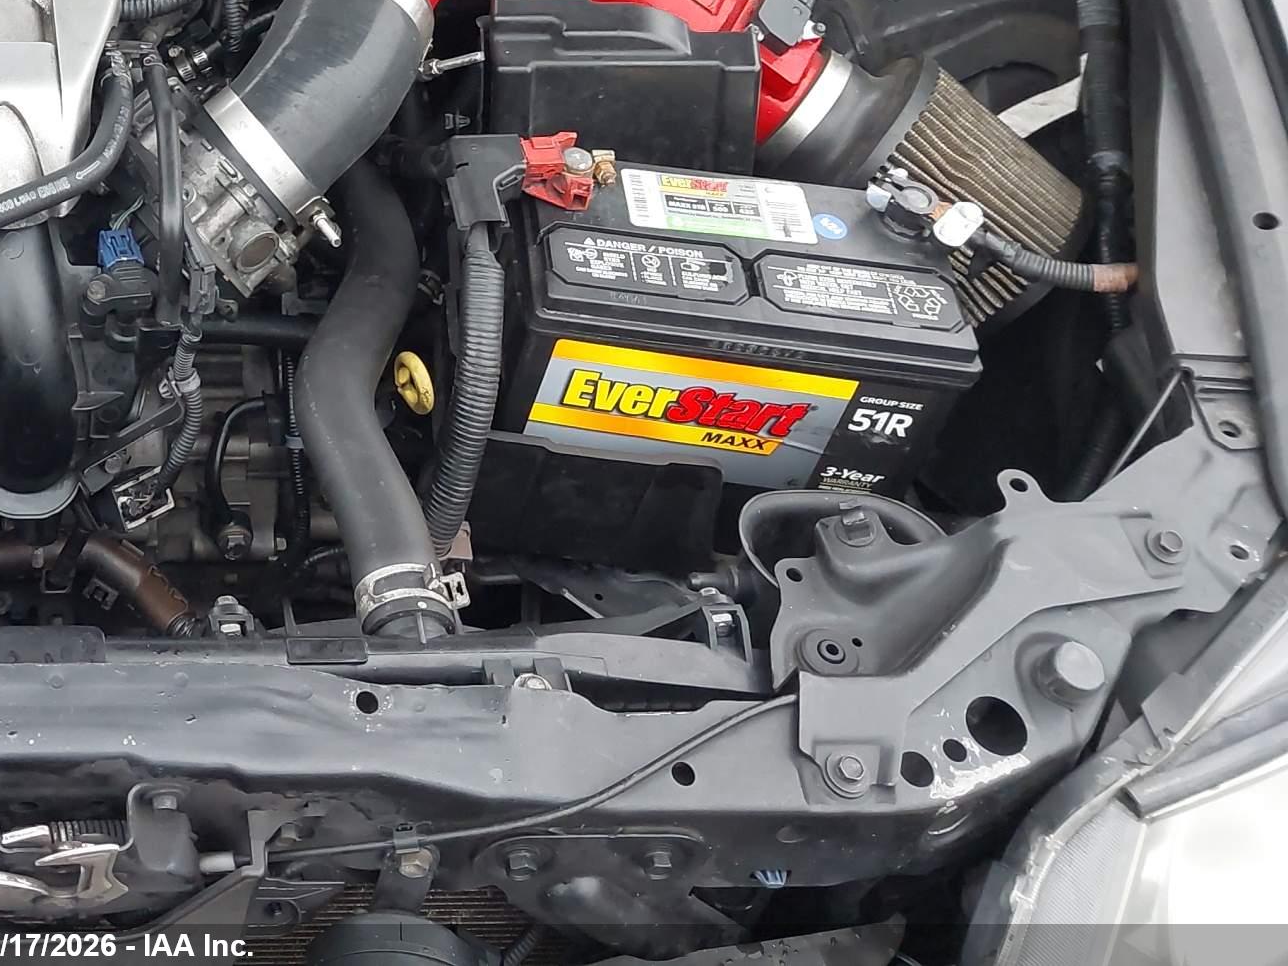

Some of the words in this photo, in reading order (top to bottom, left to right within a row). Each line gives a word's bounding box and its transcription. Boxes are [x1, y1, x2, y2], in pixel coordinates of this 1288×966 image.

[596, 238, 647, 252] DANGER
[658, 246, 704, 259] POISON
[560, 368, 810, 438] EverStart
[859, 396, 899, 408] GROUP
[899, 401, 925, 411] SIZE
[848, 408, 913, 438] 51R
[700, 432, 769, 452] MAXX
[820, 466, 885, 484] 3-Year
[822, 477, 873, 489] WARRANTY
